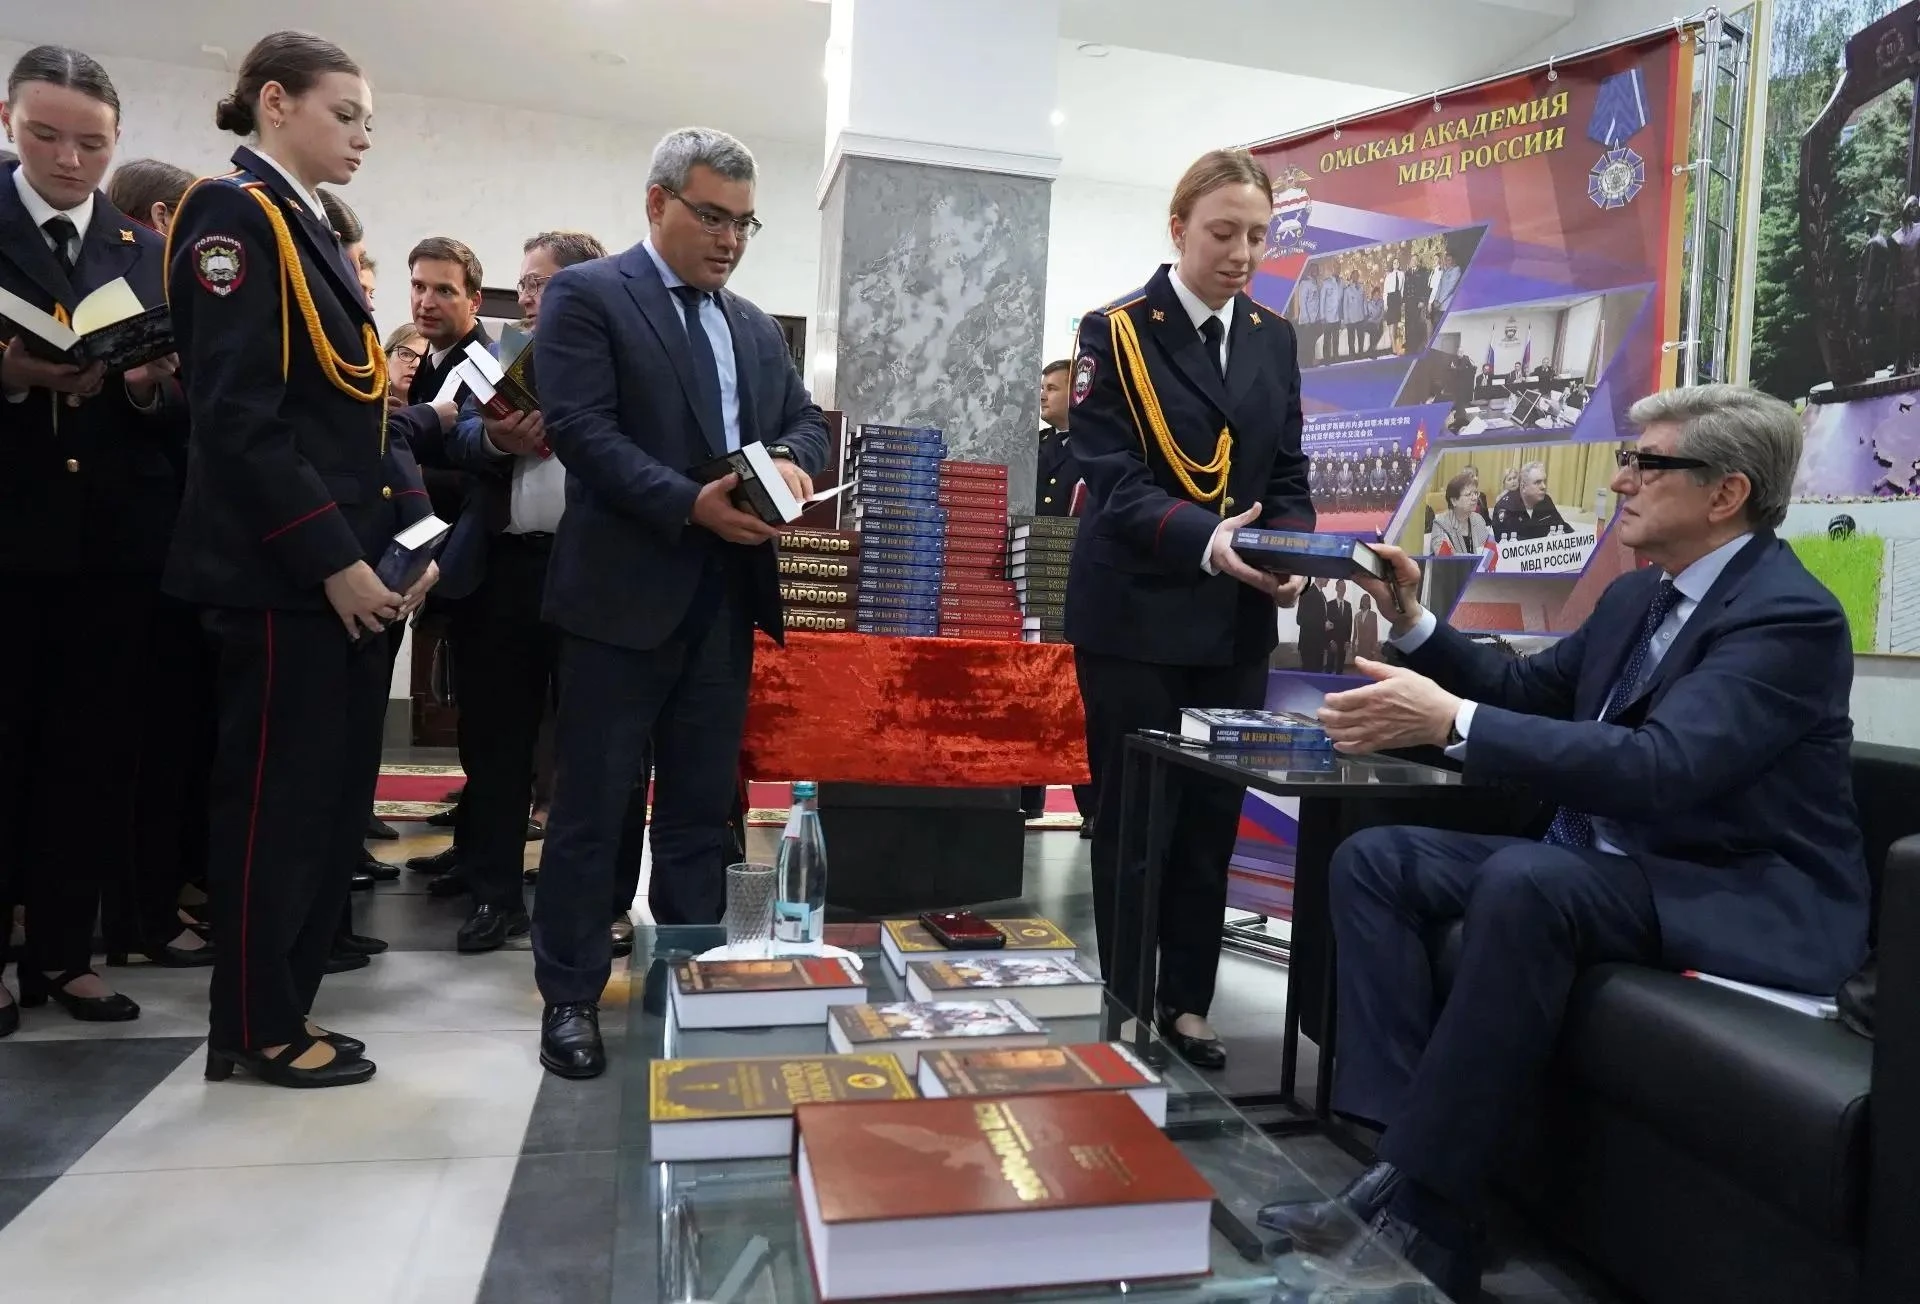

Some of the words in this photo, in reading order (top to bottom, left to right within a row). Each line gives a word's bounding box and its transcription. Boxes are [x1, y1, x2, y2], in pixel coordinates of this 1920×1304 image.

[1319, 133, 1416, 175] ОМСКАЯ
[1420, 91, 1570, 150] АКАДЕМИЯ
[1397, 153, 1454, 186] МВД
[1459, 126, 1566, 172] РОССИИ
[195, 235, 242, 251] ПОЛИЦИЯ
[212, 285, 232, 296] МВД
[781, 535, 850, 551] НАРОДОВ
[1502, 543, 1544, 560] ОМСКАЯ
[1546, 534, 1595, 552] АКАДЕМИЯ
[779, 561, 848, 577] НАРОДОВ
[1520, 558, 1542, 572] МВД
[1544, 551, 1582, 568] РОССИИ
[780, 588, 847, 604] НАРОДОВ
